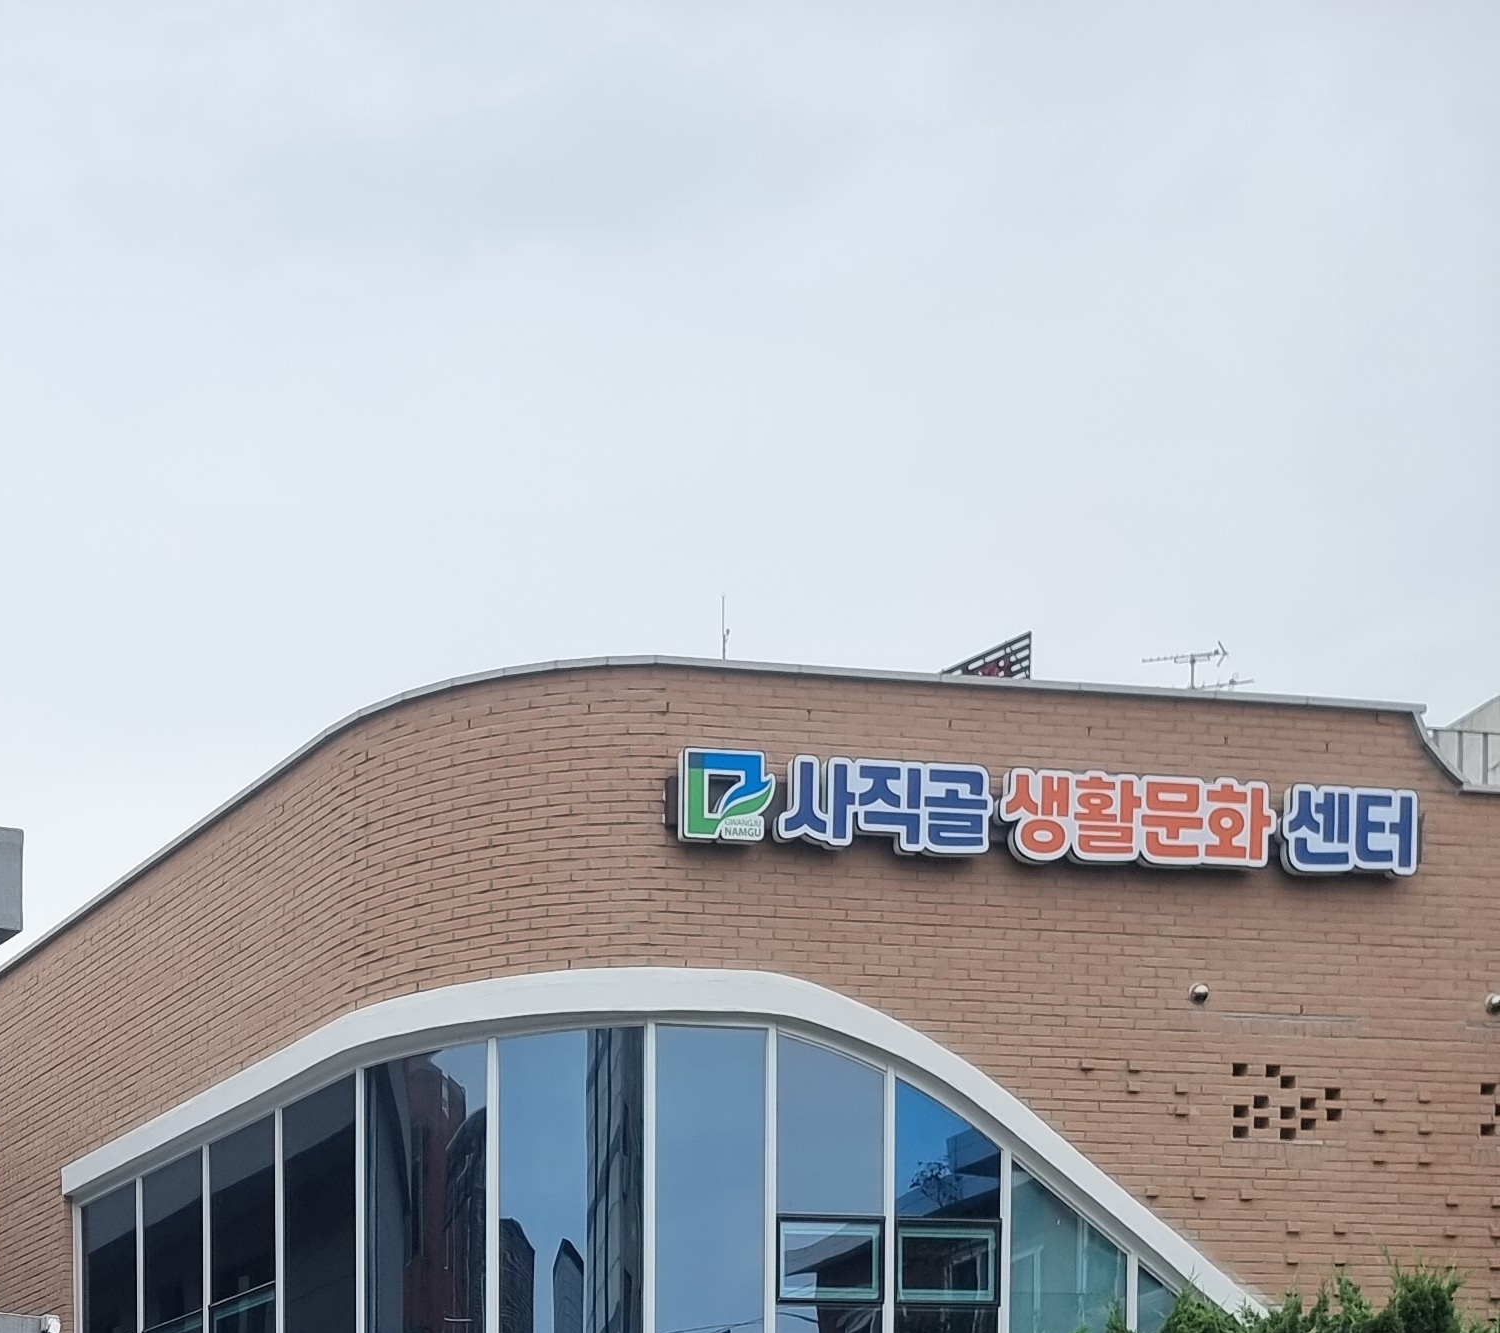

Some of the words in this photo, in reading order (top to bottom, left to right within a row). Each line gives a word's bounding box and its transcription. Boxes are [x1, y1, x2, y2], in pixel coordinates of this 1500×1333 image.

[783, 760, 989, 847] 사직골
[1005, 773, 1272, 861] 생활문화
[1288, 790, 1413, 868] 센터
[724, 819, 762, 827] GWANGJU
[724, 827, 762, 837] NAMGU
